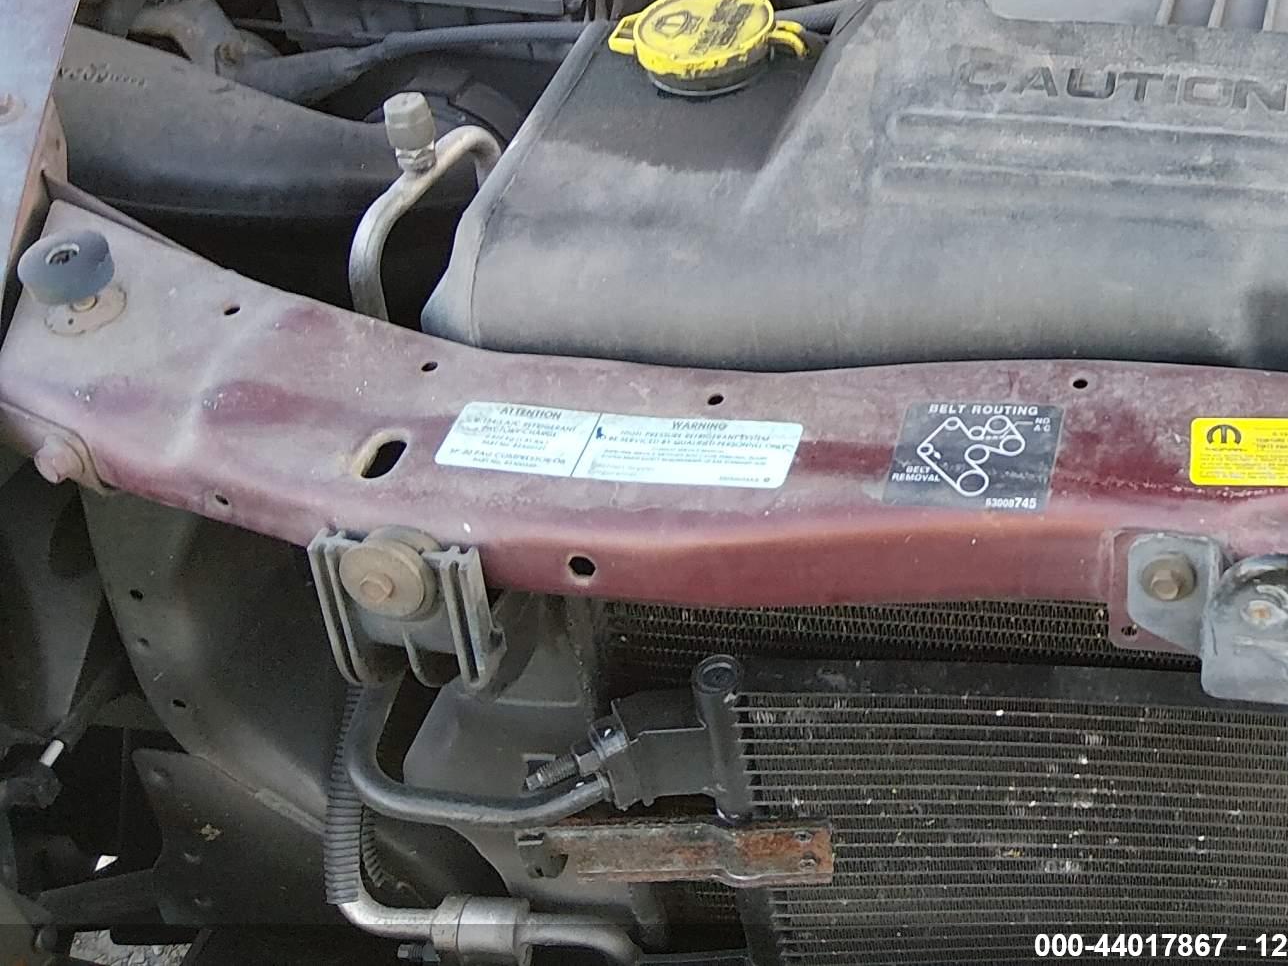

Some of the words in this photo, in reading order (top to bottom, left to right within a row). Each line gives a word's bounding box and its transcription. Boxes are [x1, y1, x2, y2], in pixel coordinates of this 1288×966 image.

[957, 60, 1288, 113] CAUTION
[499, 406, 562, 420] ATTENTION
[928, 403, 966, 415] BELT
[971, 404, 1038, 416] ROUTING
[672, 420, 728, 431] WARNING
[905, 465, 931, 473] BELT
[891, 473, 940, 483] REMOVAL
